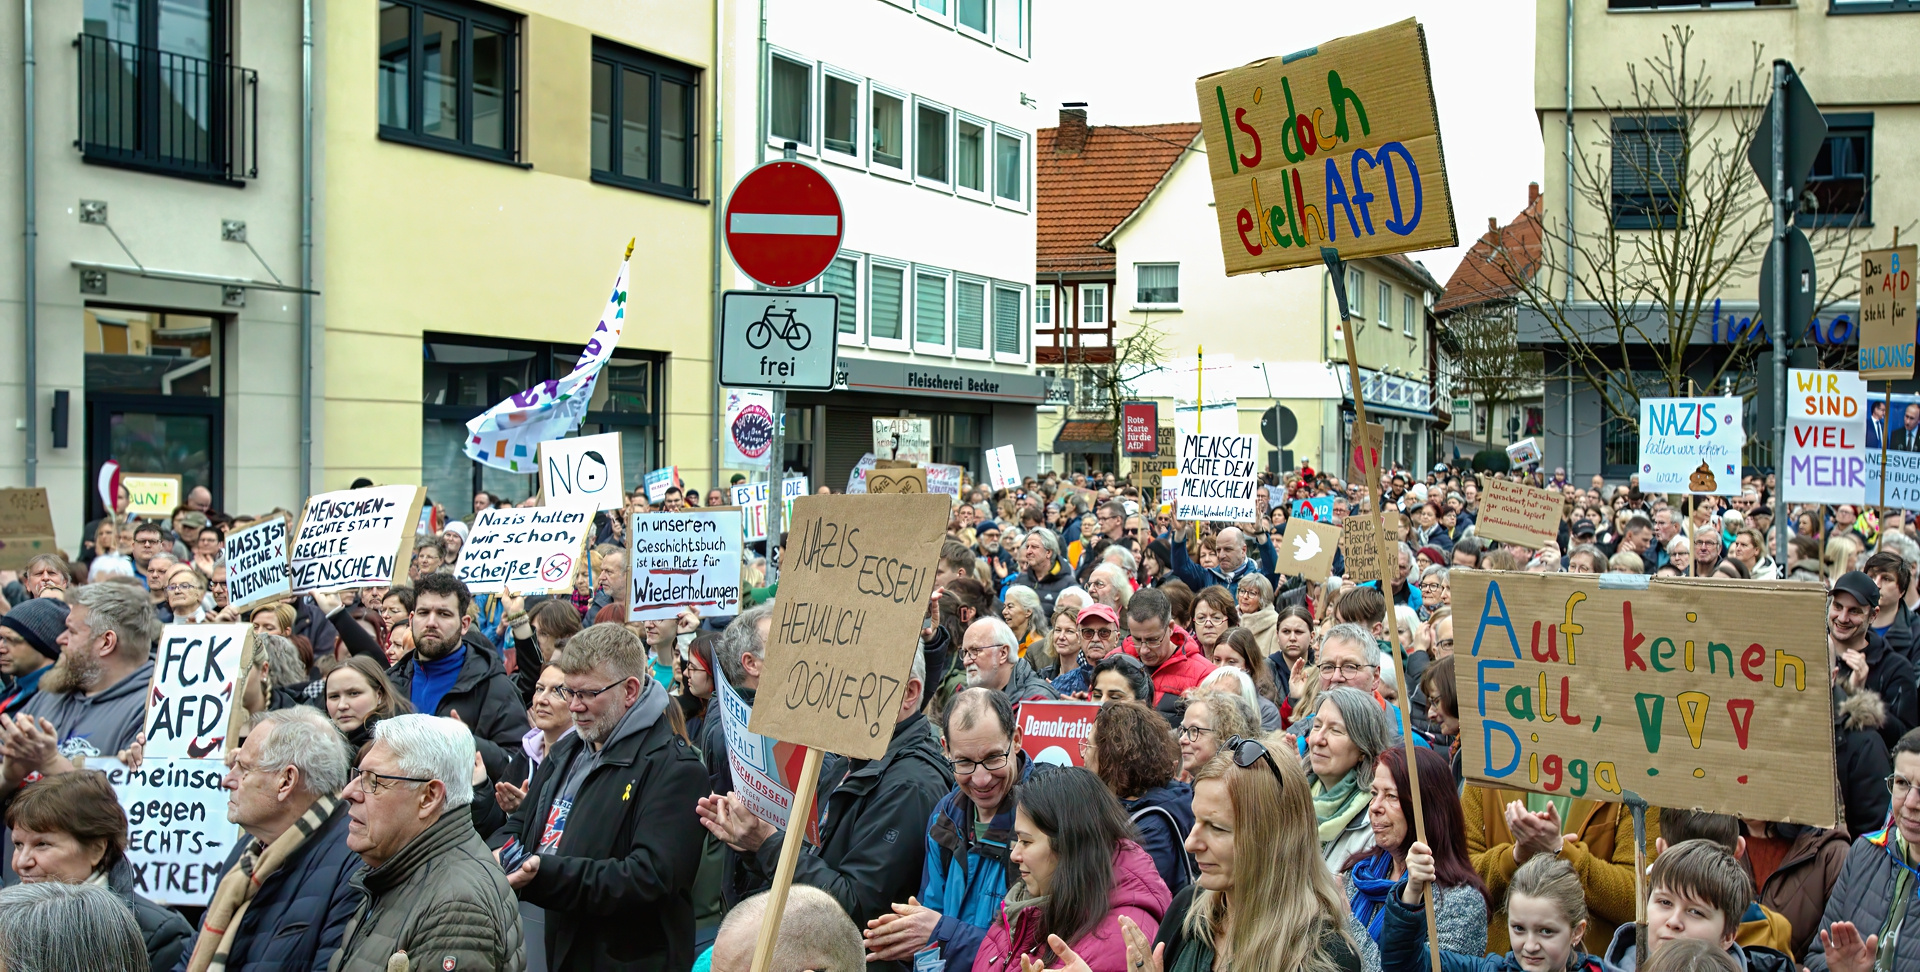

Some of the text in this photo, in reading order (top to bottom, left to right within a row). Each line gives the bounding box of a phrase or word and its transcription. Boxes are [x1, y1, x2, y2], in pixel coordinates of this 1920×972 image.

[1281, 69, 1371, 164] doch
[1865, 258, 1882, 278] Das
[1865, 270, 1910, 299] in AfD
[1864, 300, 1907, 326] steht für
[760, 356, 795, 377] frei
[1859, 343, 1915, 371] BILDUNG
[908, 372, 1000, 393] Fleischerei Becker
[1797, 372, 1841, 394] WIR
[1805, 396, 1858, 418] SIND
[1127, 416, 1145, 424] Rote
[1127, 424, 1149, 432] Karte
[1127, 432, 1152, 441] für die
[1127, 441, 1144, 450] AfD!
[1183, 434, 1252, 459] MENSCH
[1698, 441, 1728, 456] schon
[1794, 425, 1855, 449] VIEL
[549, 450, 608, 497] NO
[1181, 457, 1255, 478] ACHTE DEN
[1790, 455, 1866, 488] MEHR
[737, 489, 750, 505] ES
[786, 481, 802, 497] DIE
[1181, 477, 1255, 500] MENSCHEN
[1492, 481, 1560, 504] Wer mit Faschos
[306, 497, 395, 523] MENSCHEN-
[478, 512, 526, 527] Nazis
[1486, 503, 1546, 520] gar nichts kapiert
[300, 517, 394, 540] RECHTE STATT
[471, 529, 576, 545] wir schon,
[636, 516, 717, 533] in unserem
[1345, 517, 1372, 532] Braune
[228, 523, 286, 560] HASS IST
[294, 537, 350, 559] RECHTE
[636, 536, 726, 553] Geschichtsbuch
[794, 516, 860, 573] NAZIS
[240, 548, 272, 573] KEINE
[465, 548, 505, 561] war
[636, 554, 721, 568] ist kein Platz für
[290, 555, 394, 587] MENSCHEN
[458, 556, 543, 583] scheiße!
[857, 554, 926, 605] ESSEN
[230, 562, 291, 603] ALTERNATIVE
[633, 574, 739, 610] Wiederholungen
[778, 602, 867, 646] HEIMLICH
[1471, 580, 1807, 692] Auf keinen
[161, 635, 232, 687] FCK
[722, 685, 747, 726] OFFEN
[785, 659, 900, 739] DÖNER!
[1477, 660, 1602, 733] Fall,
[147, 694, 224, 742] AFD
[1024, 715, 1093, 739] Demokratie
[724, 722, 756, 760] ELFALT
[1482, 720, 1623, 797] Digga
[106, 762, 227, 792] emeinsa
[729, 749, 788, 807] GESCHLOSSEN
[742, 785, 760, 803] GEGEN
[129, 799, 206, 827] gegen
